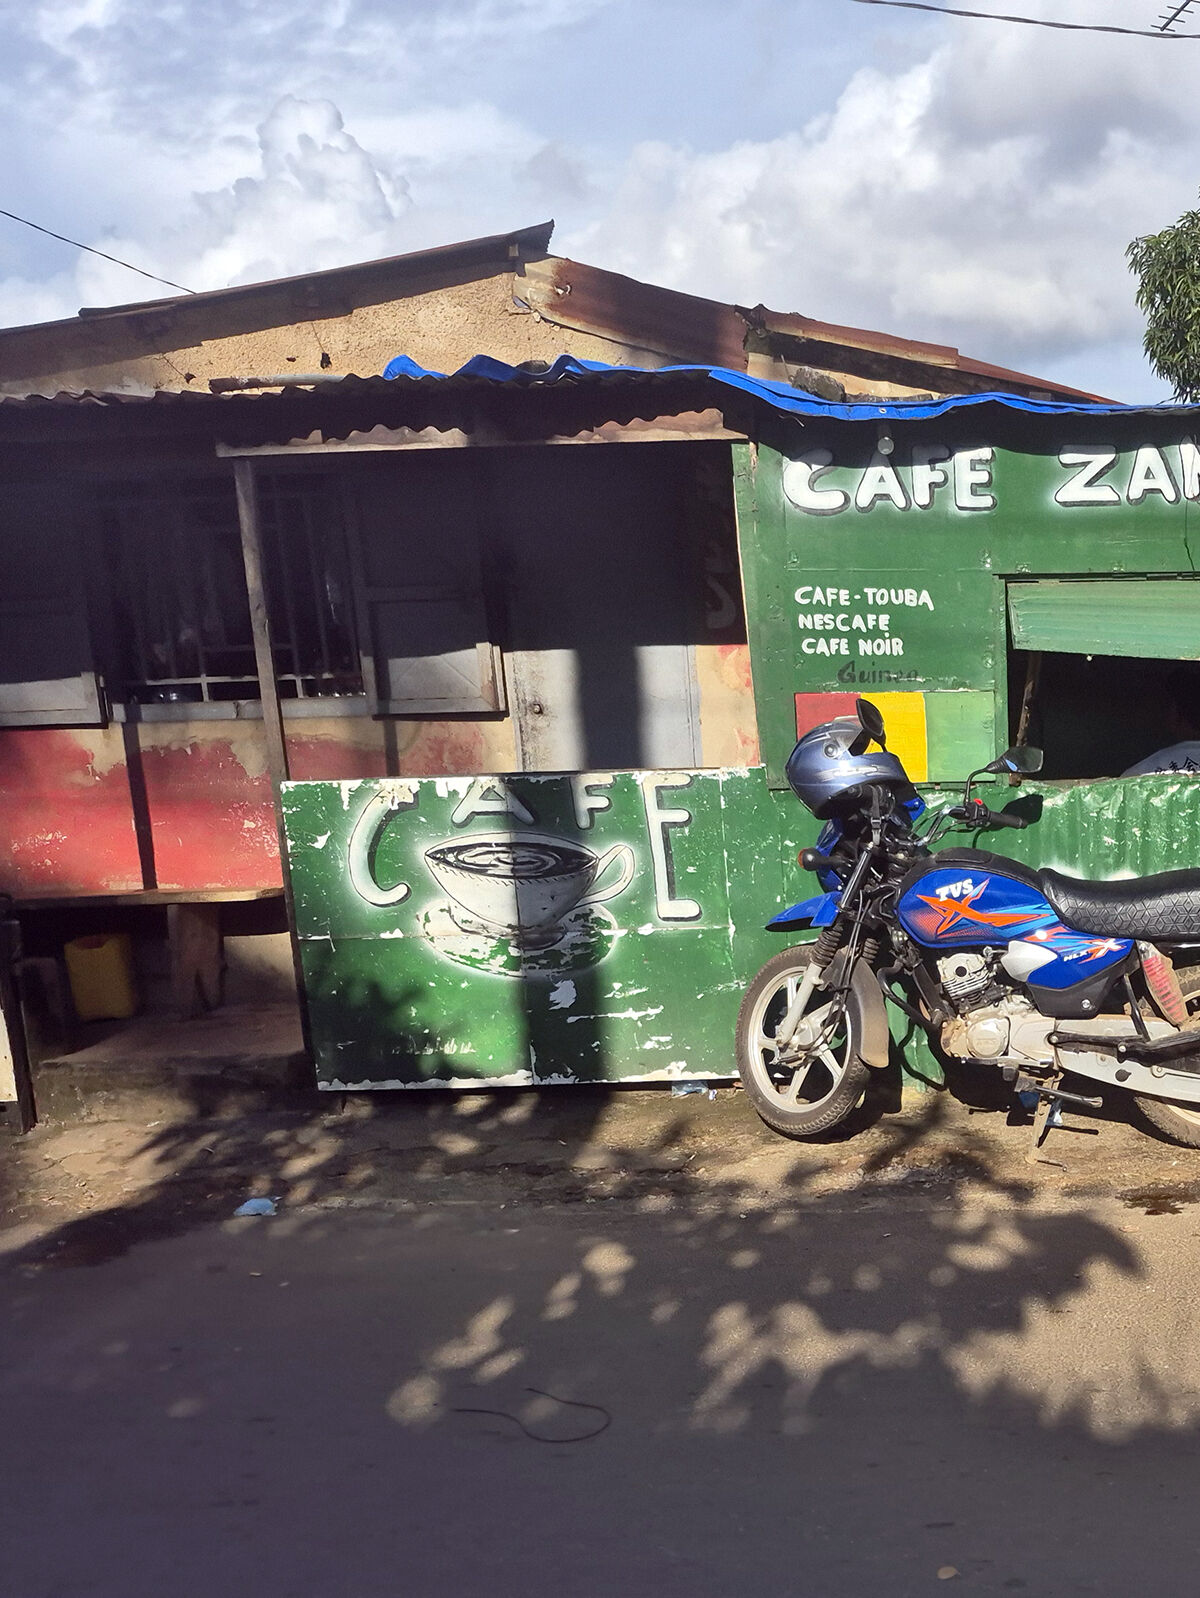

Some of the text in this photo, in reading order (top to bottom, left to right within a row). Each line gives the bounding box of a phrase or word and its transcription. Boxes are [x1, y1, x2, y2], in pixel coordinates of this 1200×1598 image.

[782, 444, 998, 516] CAFE
[798, 613, 891, 633] NESCAFE
[801, 637, 850, 657] CAFE
[348, 773, 703, 923] CAFE
[935, 878, 974, 902] TVS
